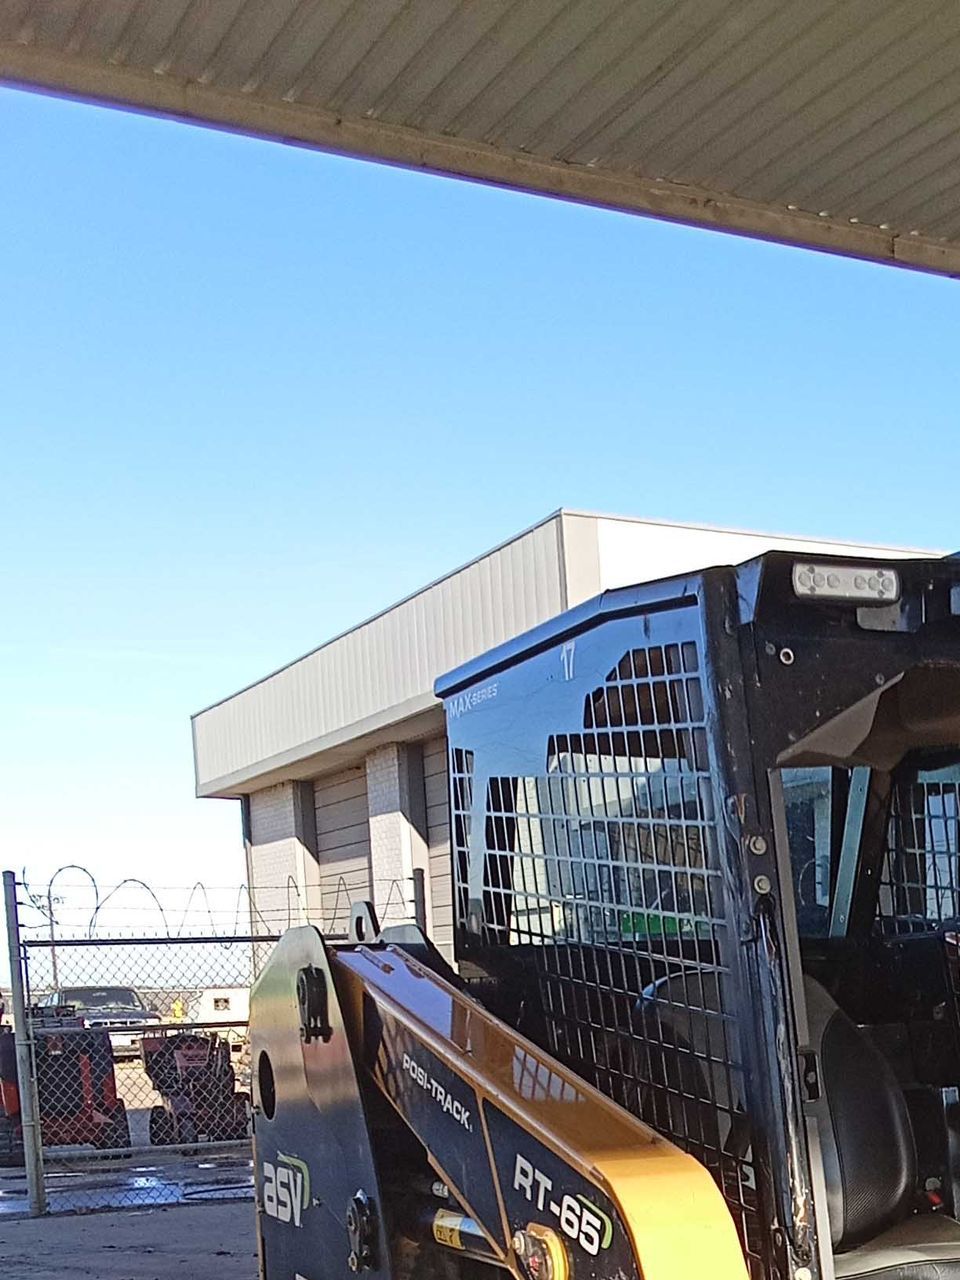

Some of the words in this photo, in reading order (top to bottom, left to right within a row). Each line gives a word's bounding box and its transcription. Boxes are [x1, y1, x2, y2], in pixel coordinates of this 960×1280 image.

[560, 641, 576, 680] 17
[403, 1053, 470, 1131] POSI-TRACK
[513, 1153, 602, 1256] RT-65
